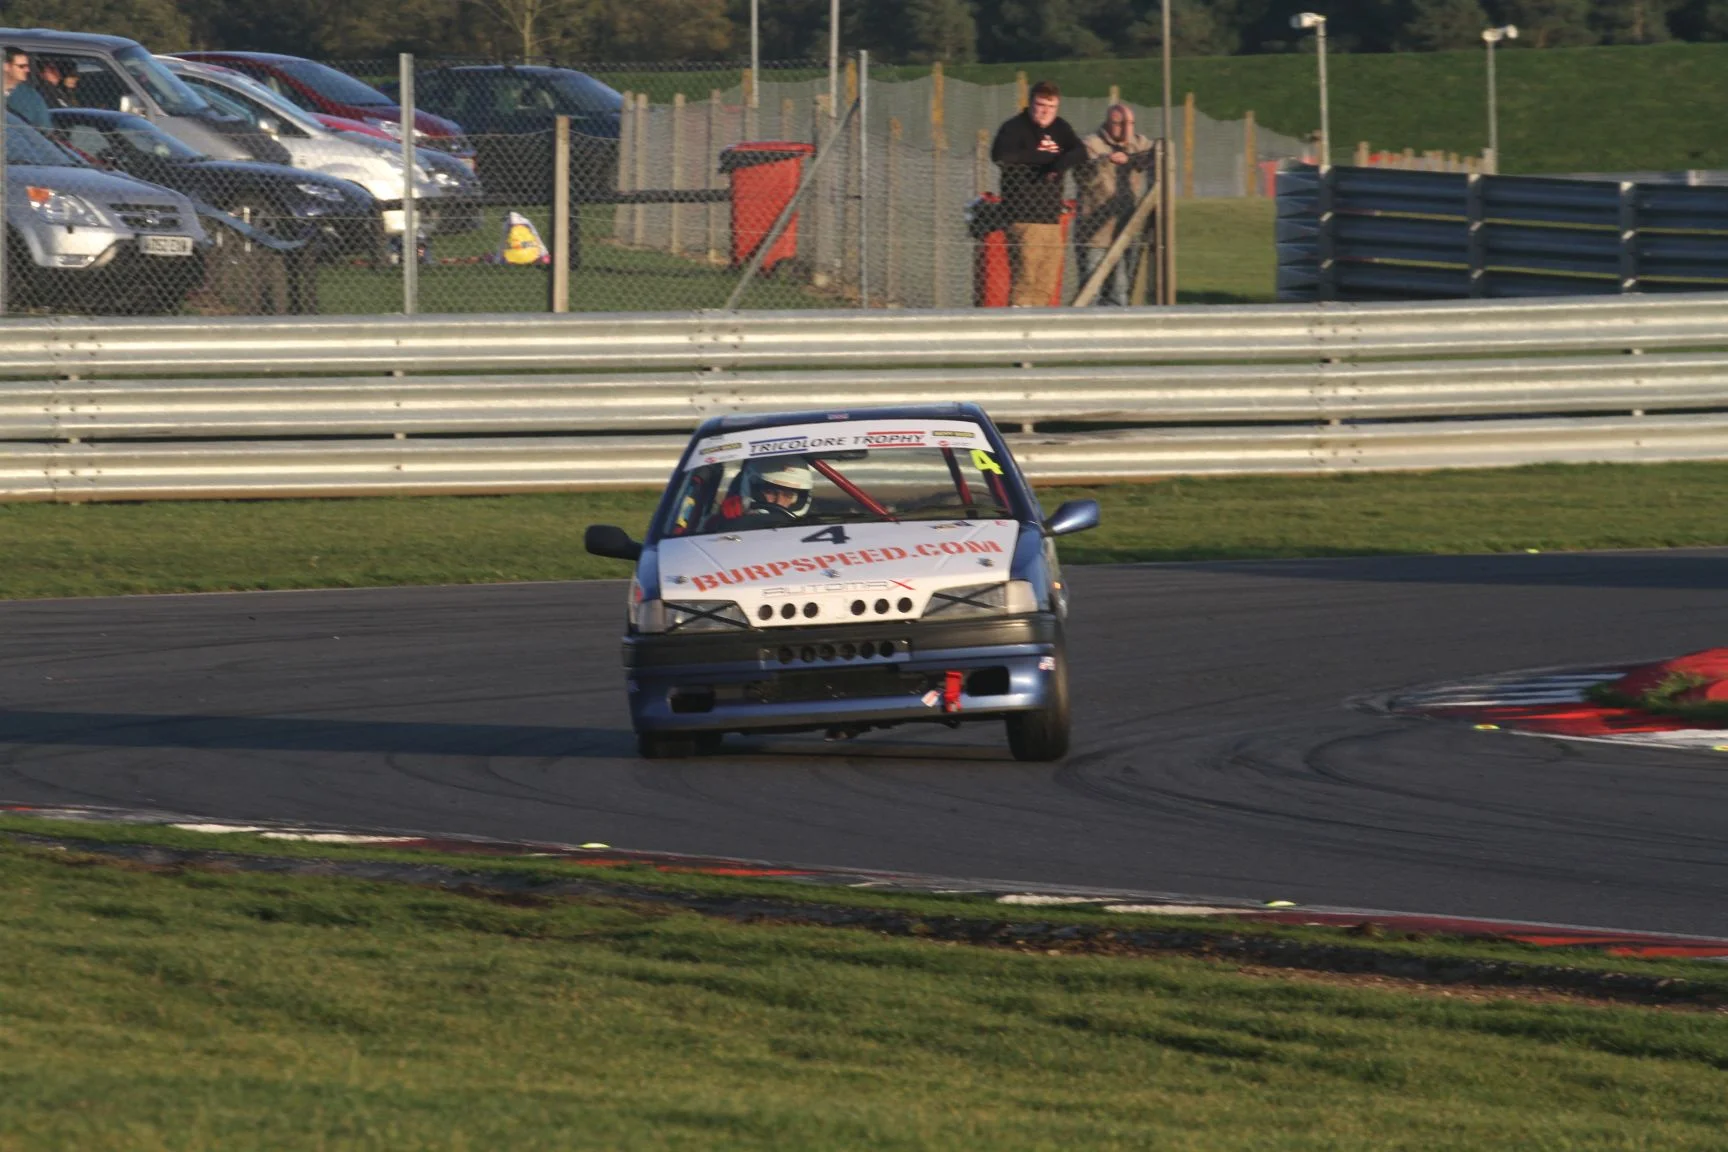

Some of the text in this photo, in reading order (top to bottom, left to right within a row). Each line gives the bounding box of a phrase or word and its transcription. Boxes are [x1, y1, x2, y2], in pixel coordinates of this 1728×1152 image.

[751, 436, 848, 453] TRICOLORE
[853, 434, 925, 445] TROPHY
[969, 449, 1004, 474] 4
[801, 525, 851, 544] 4
[691, 540, 1004, 592] BURPSPEED.COM
